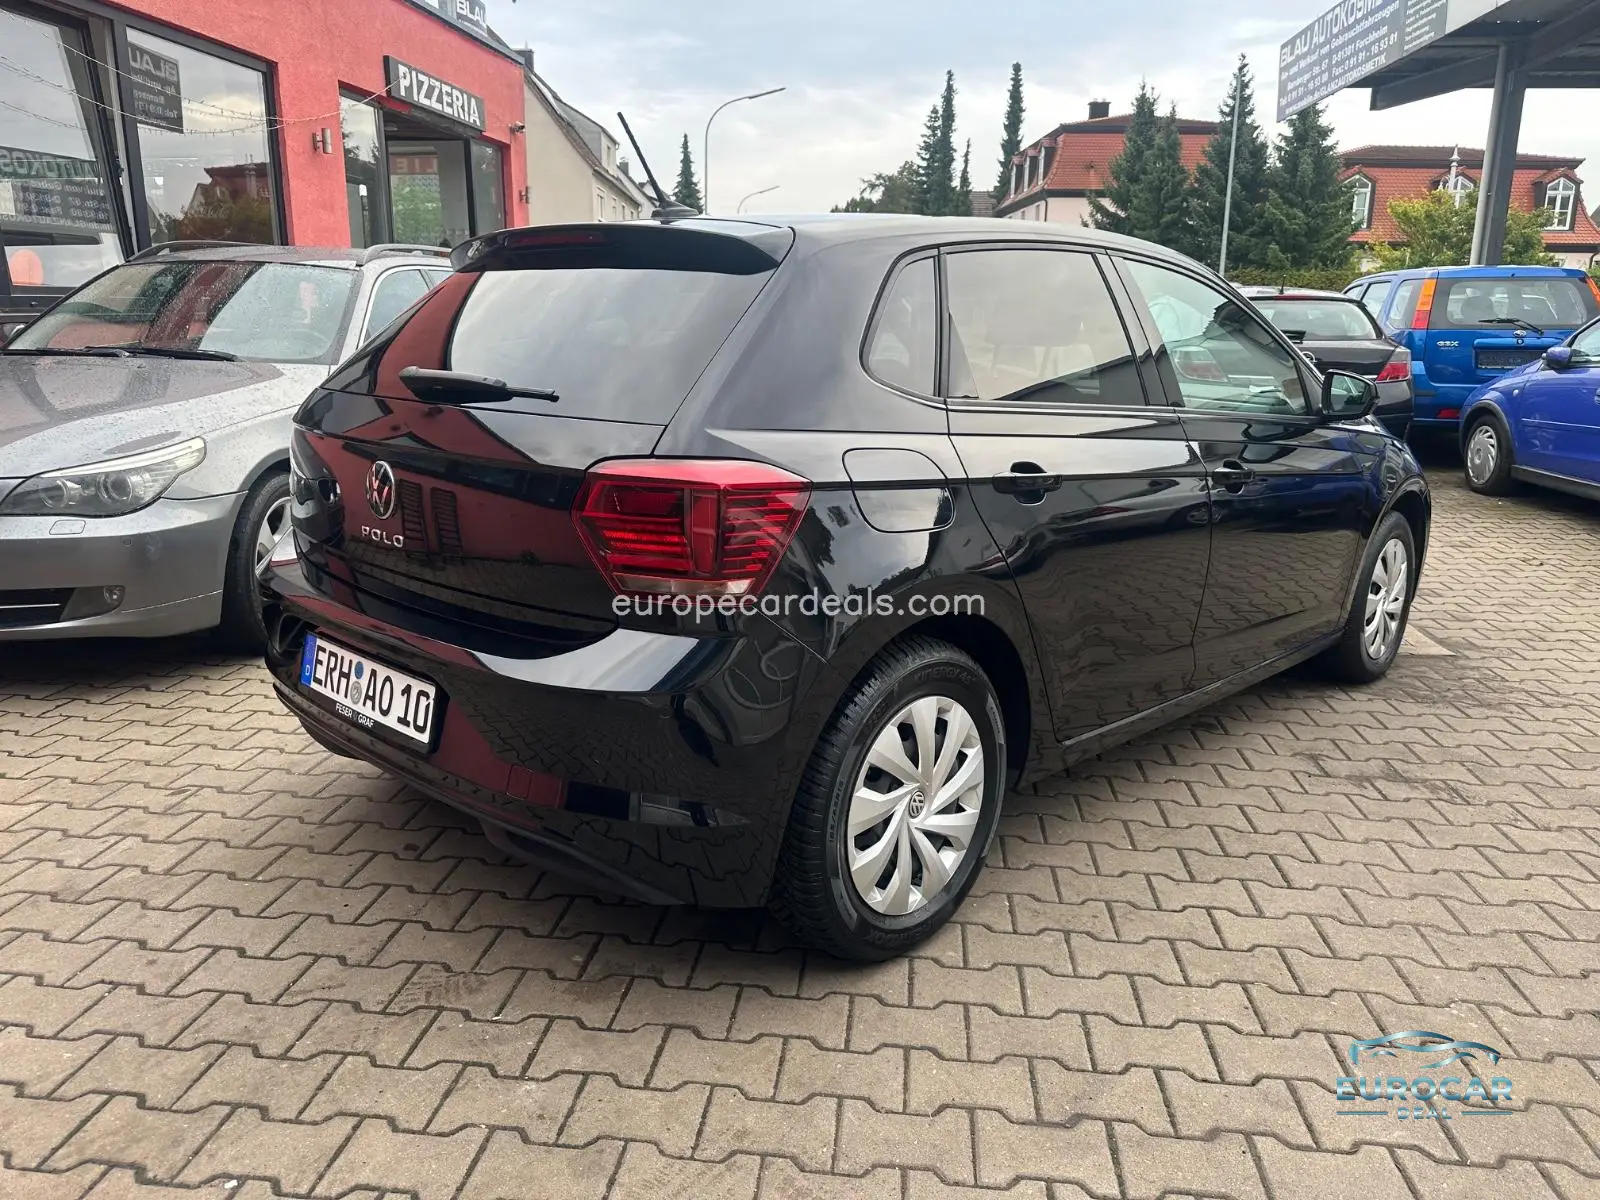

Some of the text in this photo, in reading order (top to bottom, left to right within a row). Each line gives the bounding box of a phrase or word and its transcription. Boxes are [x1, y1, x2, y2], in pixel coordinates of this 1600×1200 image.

[1281, 28, 1309, 66] BLAU
[1356, 25, 1389, 51] Forchheim
[397, 63, 481, 127] PIZZERIA
[361, 525, 404, 548] POLO
[313, 645, 431, 734] ERH AO 10
[335, 703, 375, 728] FESER GRAF
